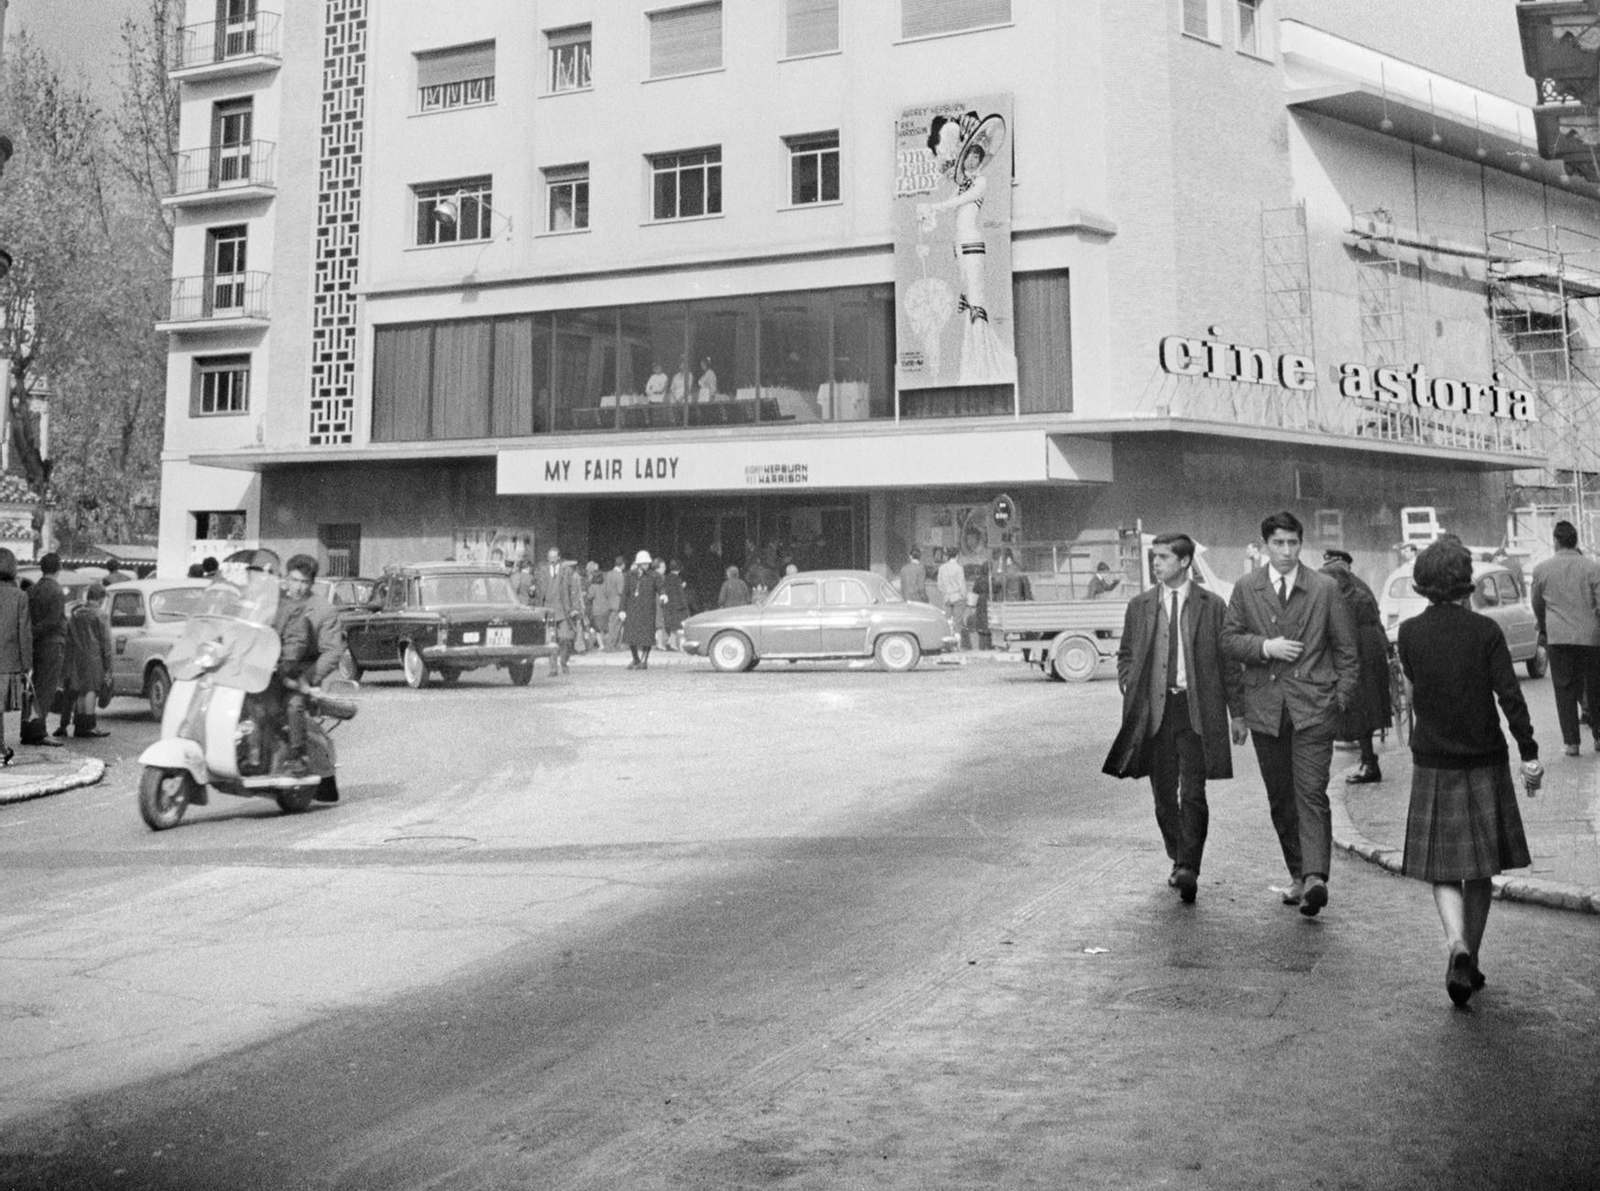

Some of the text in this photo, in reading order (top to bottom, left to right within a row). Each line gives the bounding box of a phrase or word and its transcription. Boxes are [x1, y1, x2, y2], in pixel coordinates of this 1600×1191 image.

[1159, 325, 1539, 422] cine astoria
[545, 457, 679, 481] MY FAIR LADY
[763, 463, 808, 474] HEPBURN
[758, 474, 808, 484] HARRISON
